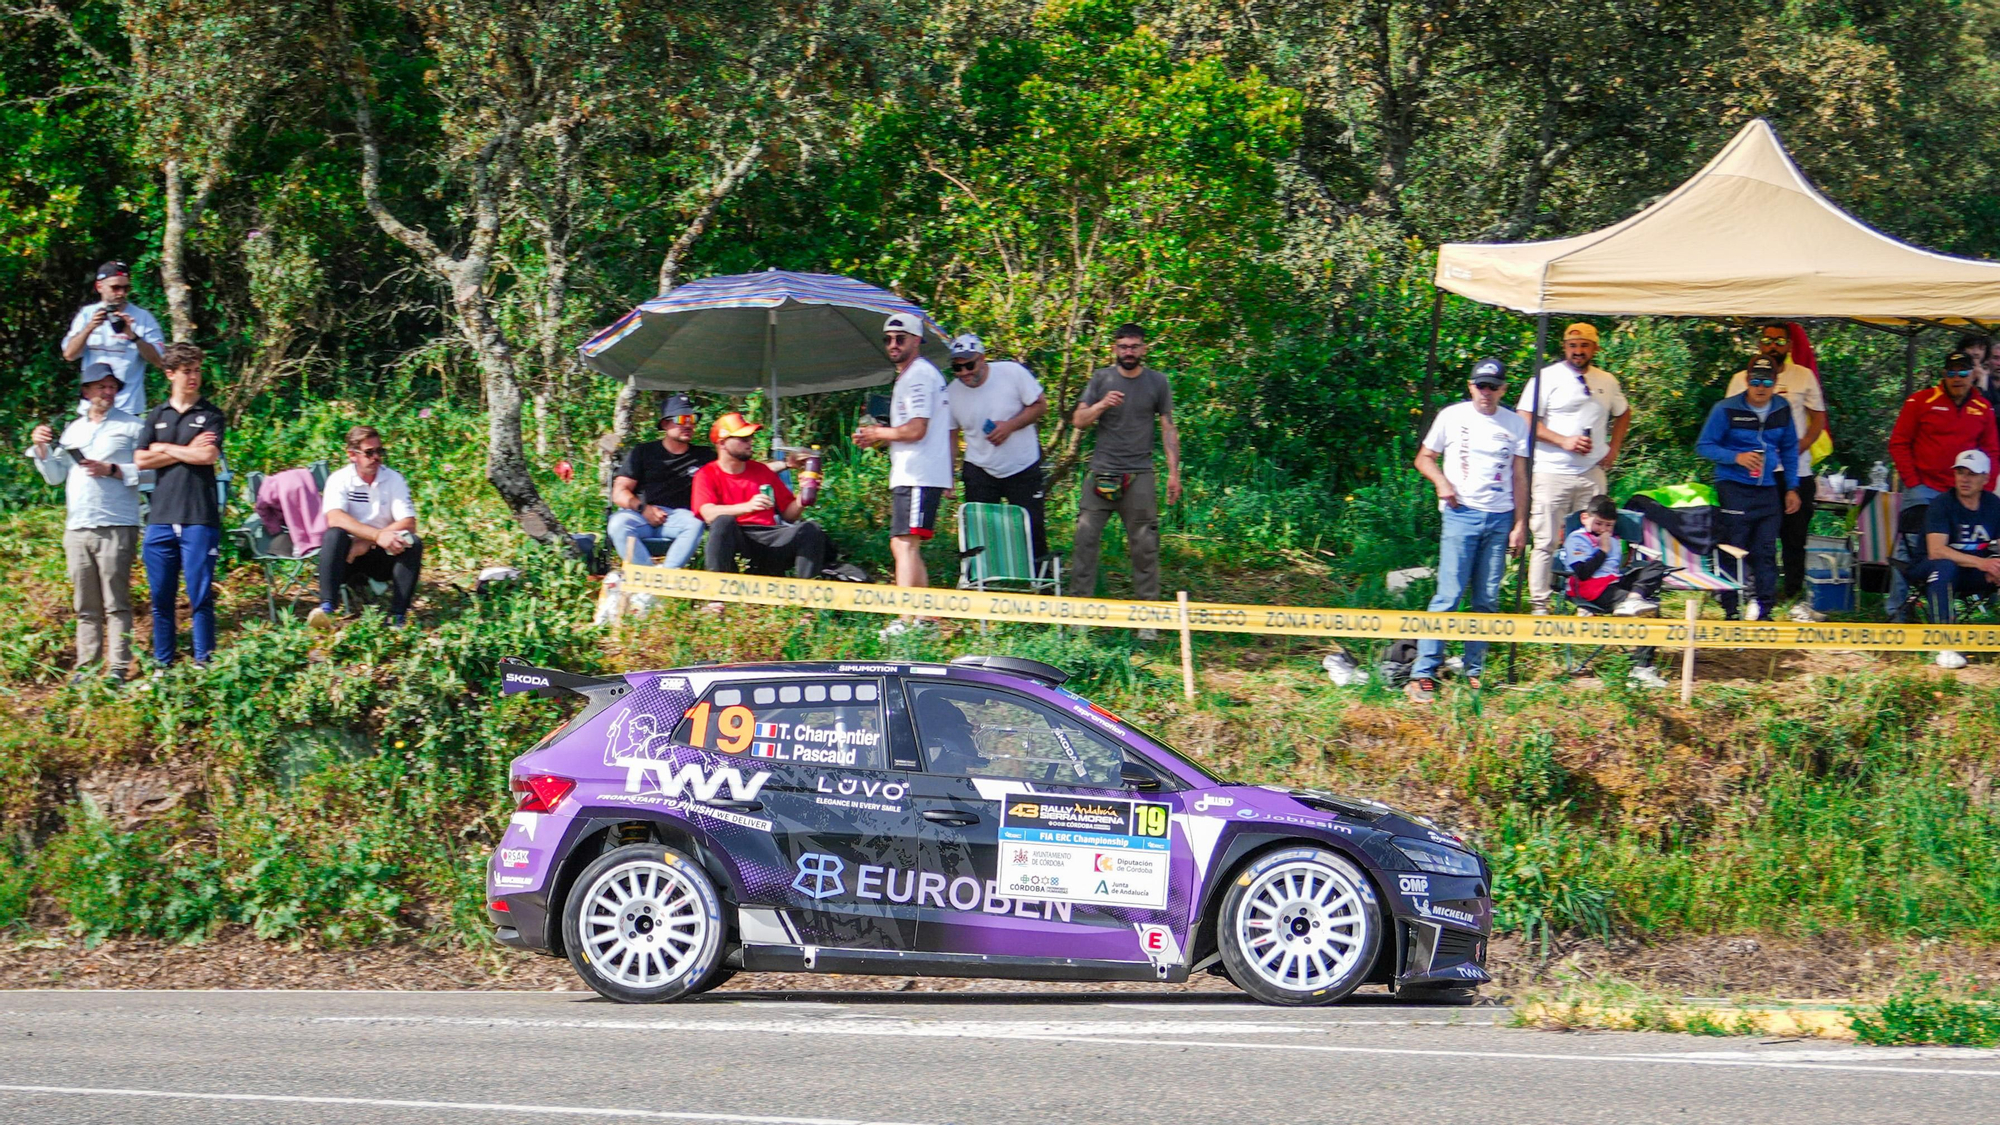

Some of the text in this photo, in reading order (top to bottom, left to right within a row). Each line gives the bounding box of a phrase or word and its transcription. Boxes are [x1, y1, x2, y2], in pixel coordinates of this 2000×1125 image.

[635, 571, 700, 592] PUBLICO
[719, 579, 834, 603] ZONA PUBLICO
[853, 589, 970, 612] ZONA PUBLICO
[990, 598, 1108, 619] ZONA PUBLICO
[1128, 606, 1172, 623] ZONA
[1265, 612, 1381, 632] ZONA PUBLICO
[1400, 617, 1515, 636] ZONA PUBLICO
[1533, 621, 1649, 640] ZONA PUBLICO
[1713, 626, 1778, 643] PUBLICO
[1795, 628, 1905, 645] ZONA PUBLICO
[1922, 630, 1962, 645] ZONA
[839, 664, 898, 674] SIMUMOTION
[684, 702, 756, 754] 19
[779, 724, 880, 747] T. Charpentier
[776, 744, 856, 765] L. Pascaud
[629, 795, 662, 805] START
[663, 798, 677, 807] TO
[677, 801, 714, 816] FINISH
[717, 811, 730, 821] WE
[732, 813, 767, 829] DELIVER
[816, 797, 850, 807] ELEGANCE
[859, 802, 881, 811] EVERY
[881, 804, 901, 812] SMILE
[1008, 803, 1039, 818] 43
[1040, 804, 1073, 814] RALLY
[1135, 805, 1166, 837] 19
[1039, 832, 1129, 848] FIA ERC Championship
[1032, 851, 1072, 860] AYUNTAMIENTO
[1040, 858, 1064, 867] CÓRDOBA
[1117, 858, 1153, 867] Diputación
[1126, 865, 1153, 874] Córdoba
[1010, 883, 1045, 893] CÓRDOBA
[1119, 888, 1149, 897] Andalucía
[1400, 879, 1428, 892] OMP
[1432, 905, 1474, 923] MICHELIN
[1148, 932, 1162, 949] E
